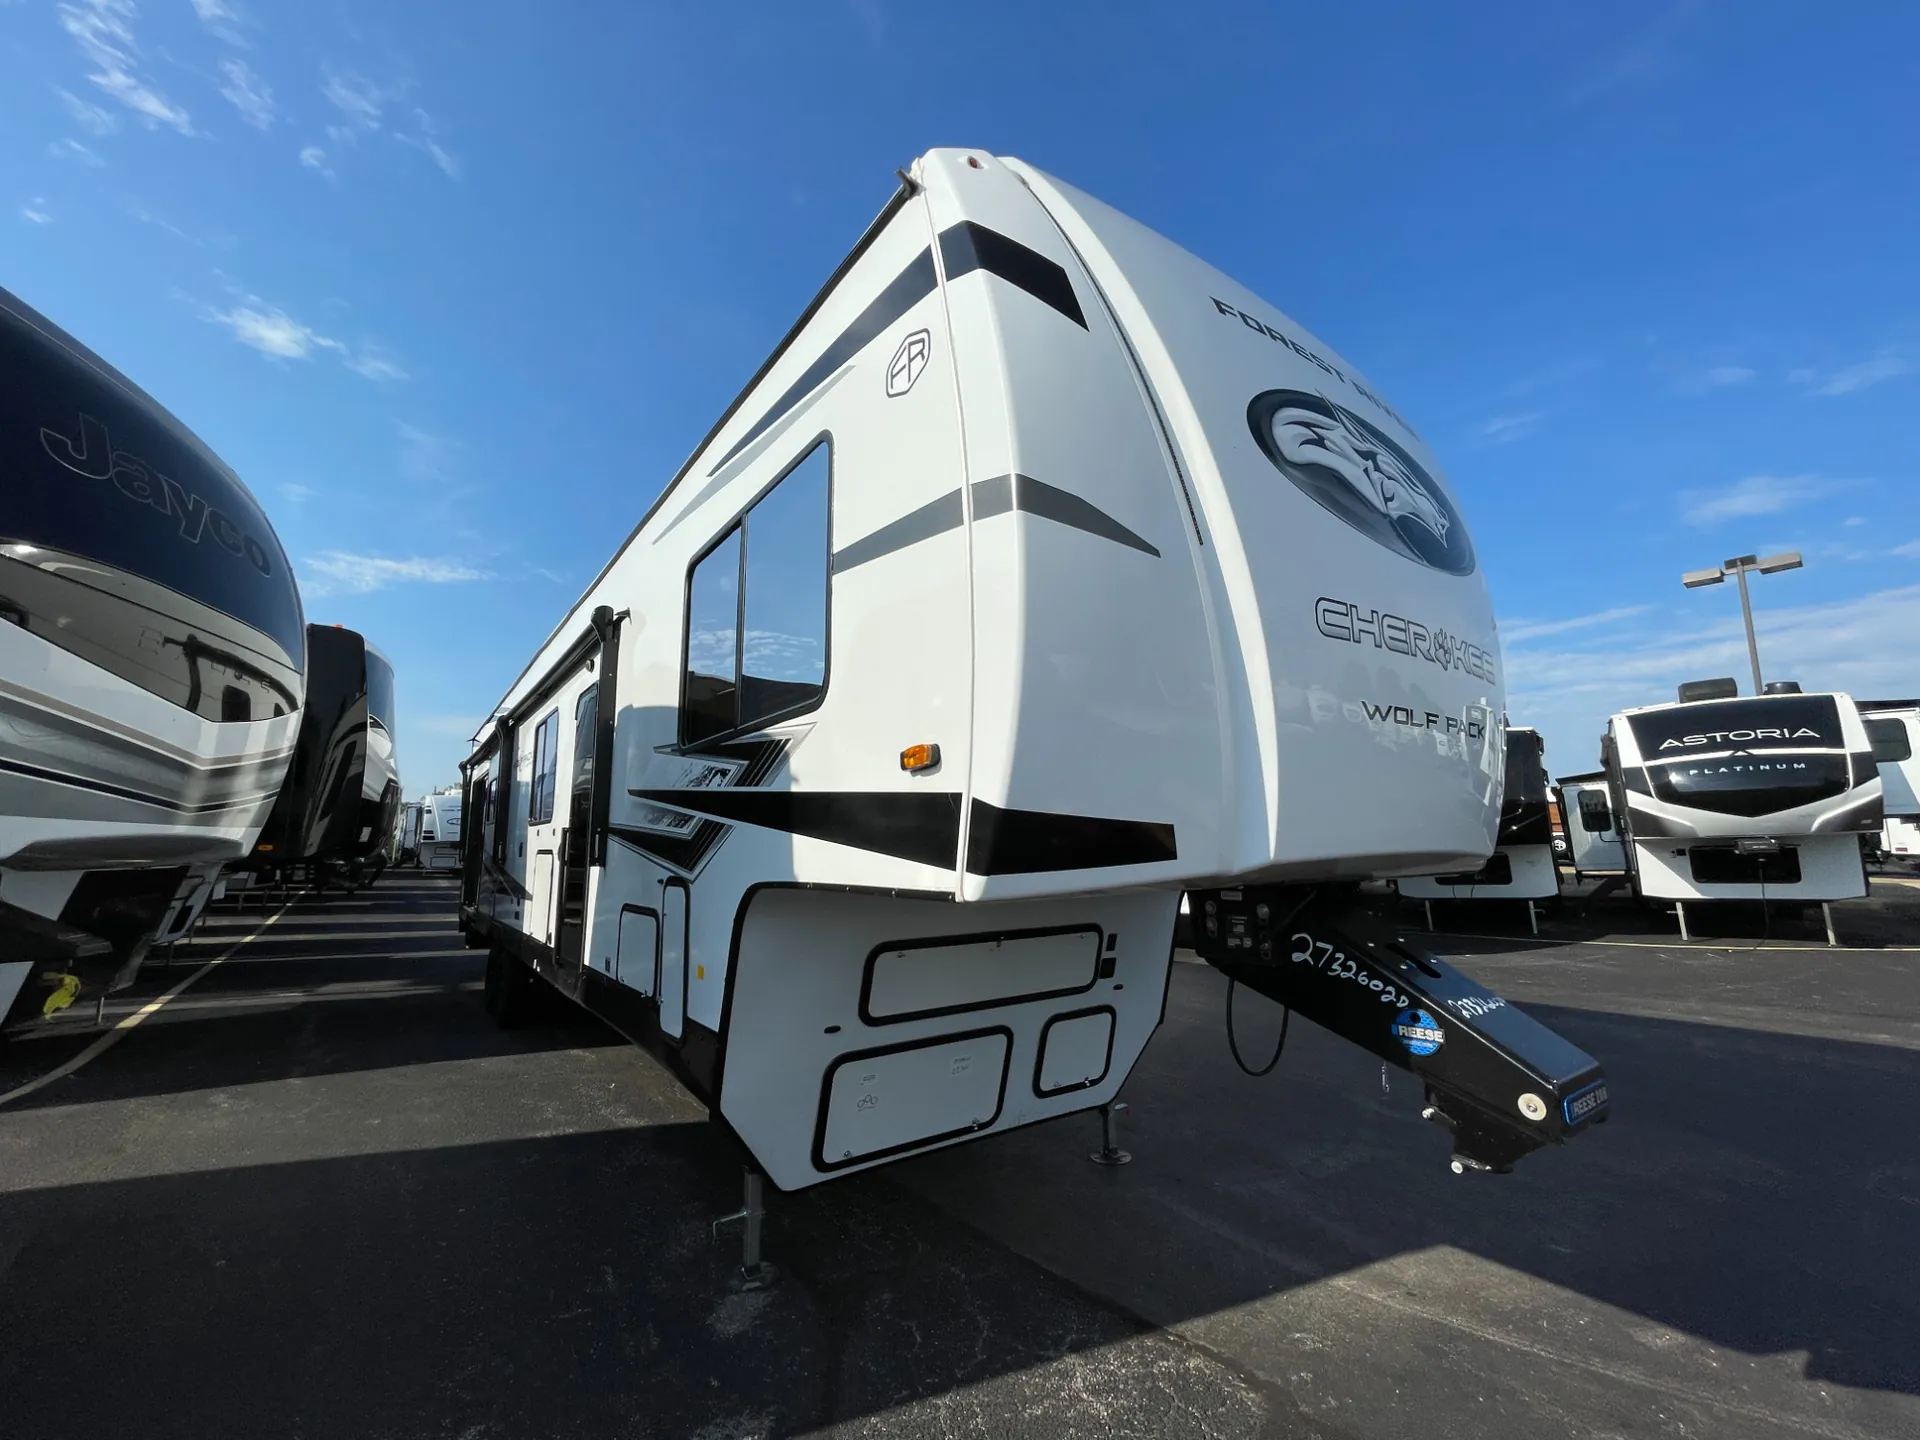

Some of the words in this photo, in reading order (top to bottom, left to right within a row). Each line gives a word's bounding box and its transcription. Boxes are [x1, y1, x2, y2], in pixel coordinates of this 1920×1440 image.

[1208, 295, 1346, 383] FOREST
[39, 412, 271, 577] Jayco
[1361, 700, 1440, 730] WOLF
[1445, 715, 1485, 741] PACK
[1658, 727, 1821, 751] ASTORIA
[1689, 762, 1808, 776] PLATINUM
[1397, 1024, 1445, 1043] REESE
[1572, 1093, 1597, 1117] REESE
